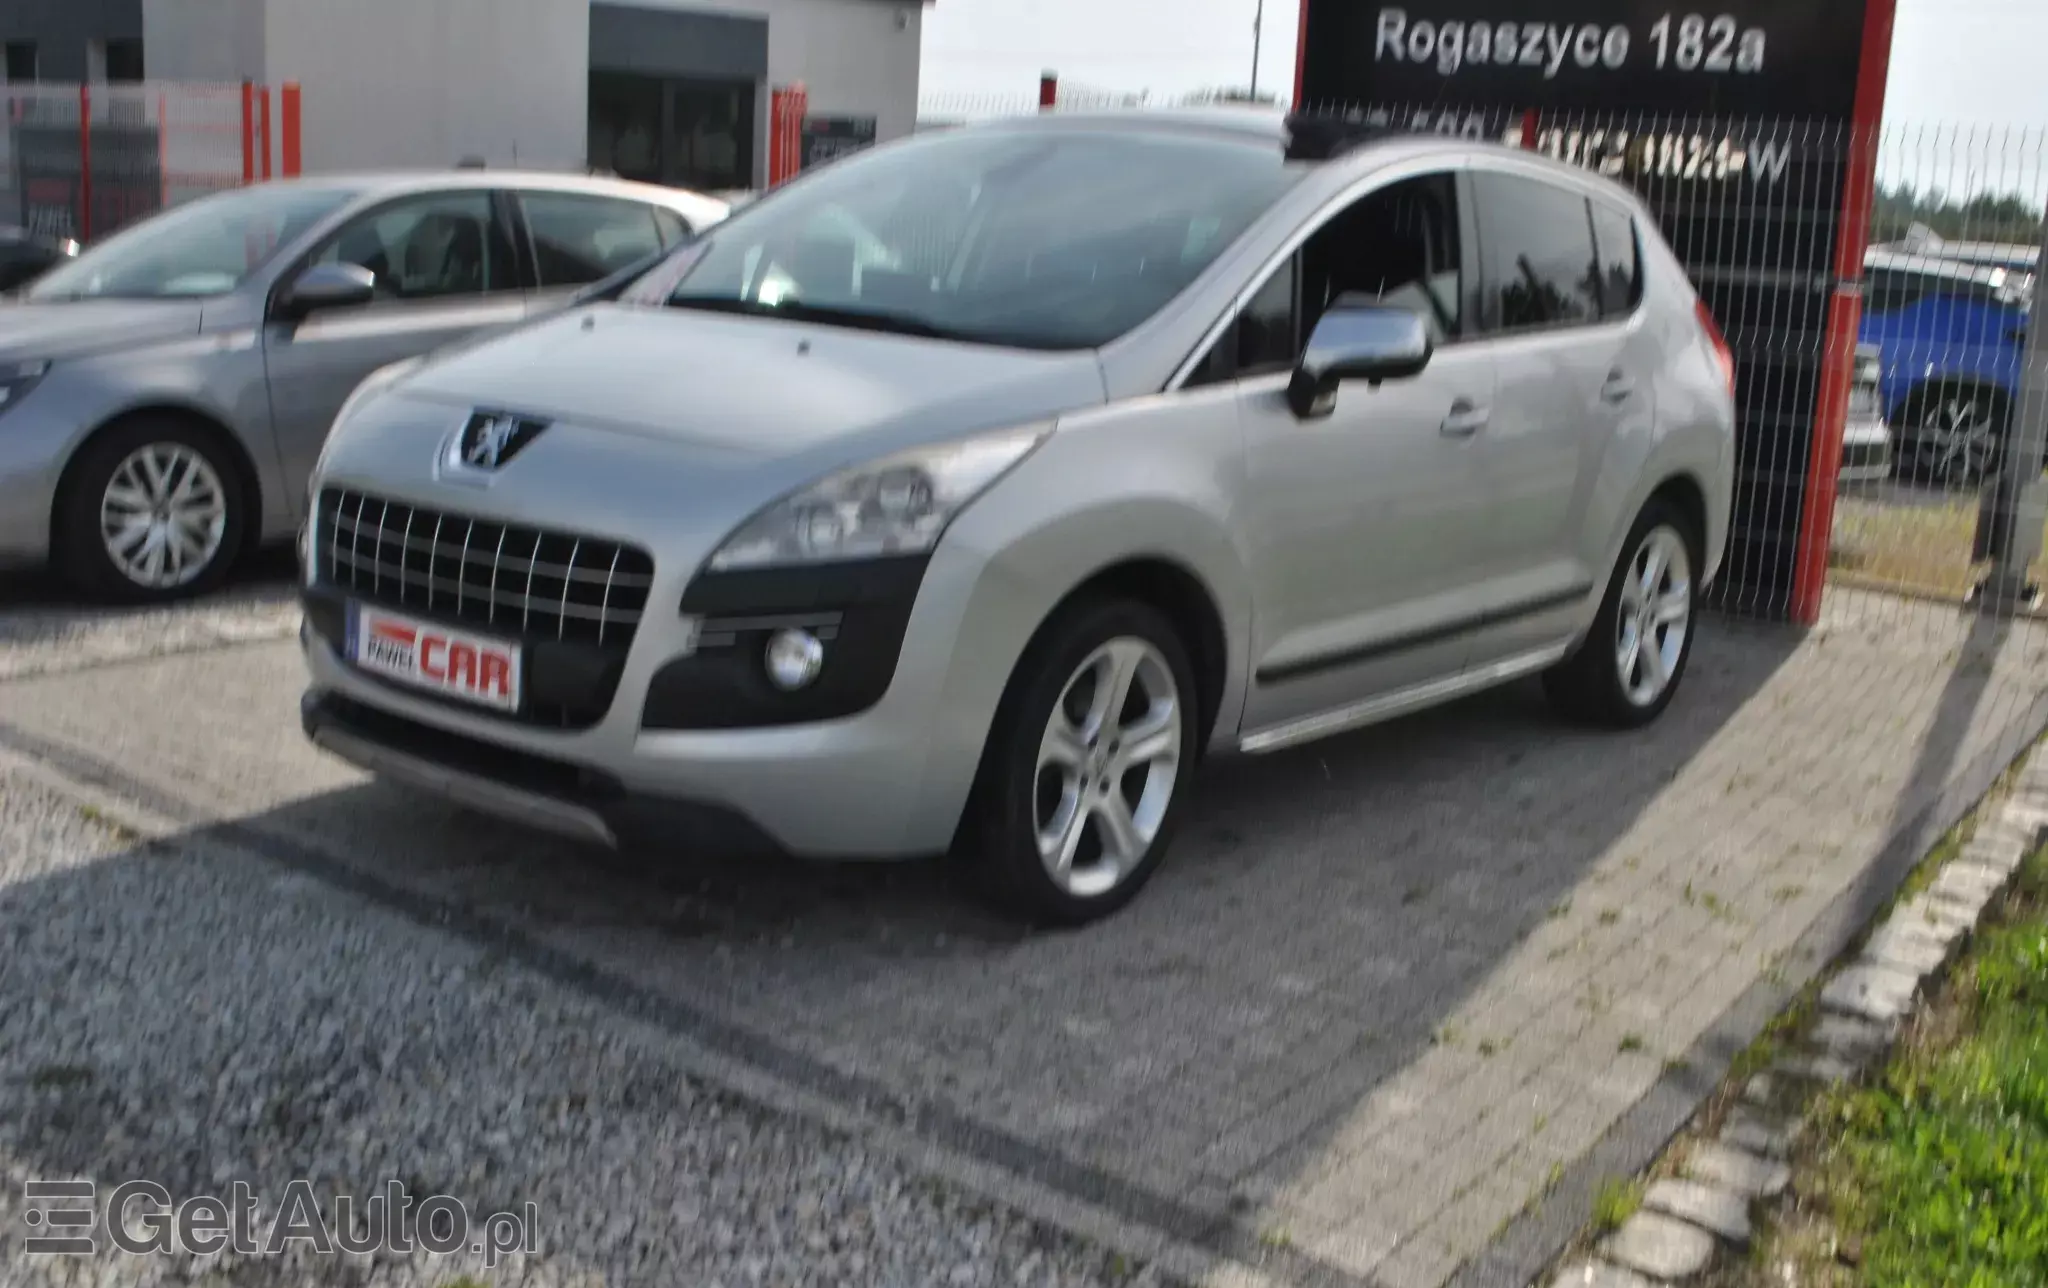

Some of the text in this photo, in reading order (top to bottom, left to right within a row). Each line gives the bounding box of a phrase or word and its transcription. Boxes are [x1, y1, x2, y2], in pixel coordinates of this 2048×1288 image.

[1375, 8, 1767, 80] Rogaszyce 182a
[419, 633, 509, 697] CAR
